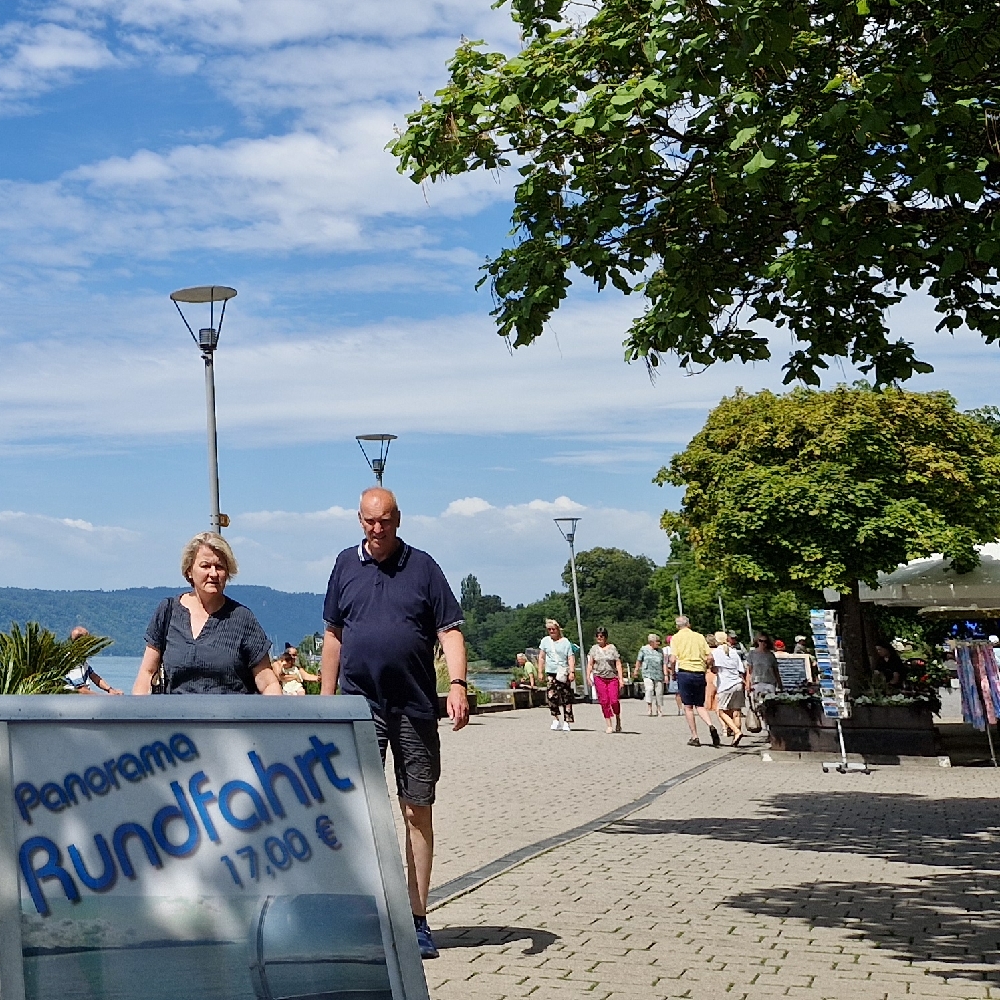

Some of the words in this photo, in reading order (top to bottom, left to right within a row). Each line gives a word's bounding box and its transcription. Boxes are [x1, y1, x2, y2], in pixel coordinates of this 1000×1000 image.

[14, 733, 199, 824] Panorama
[18, 735, 355, 916] Rundfahrt
[220, 827, 312, 889] 17,00
[315, 815, 342, 850] €
